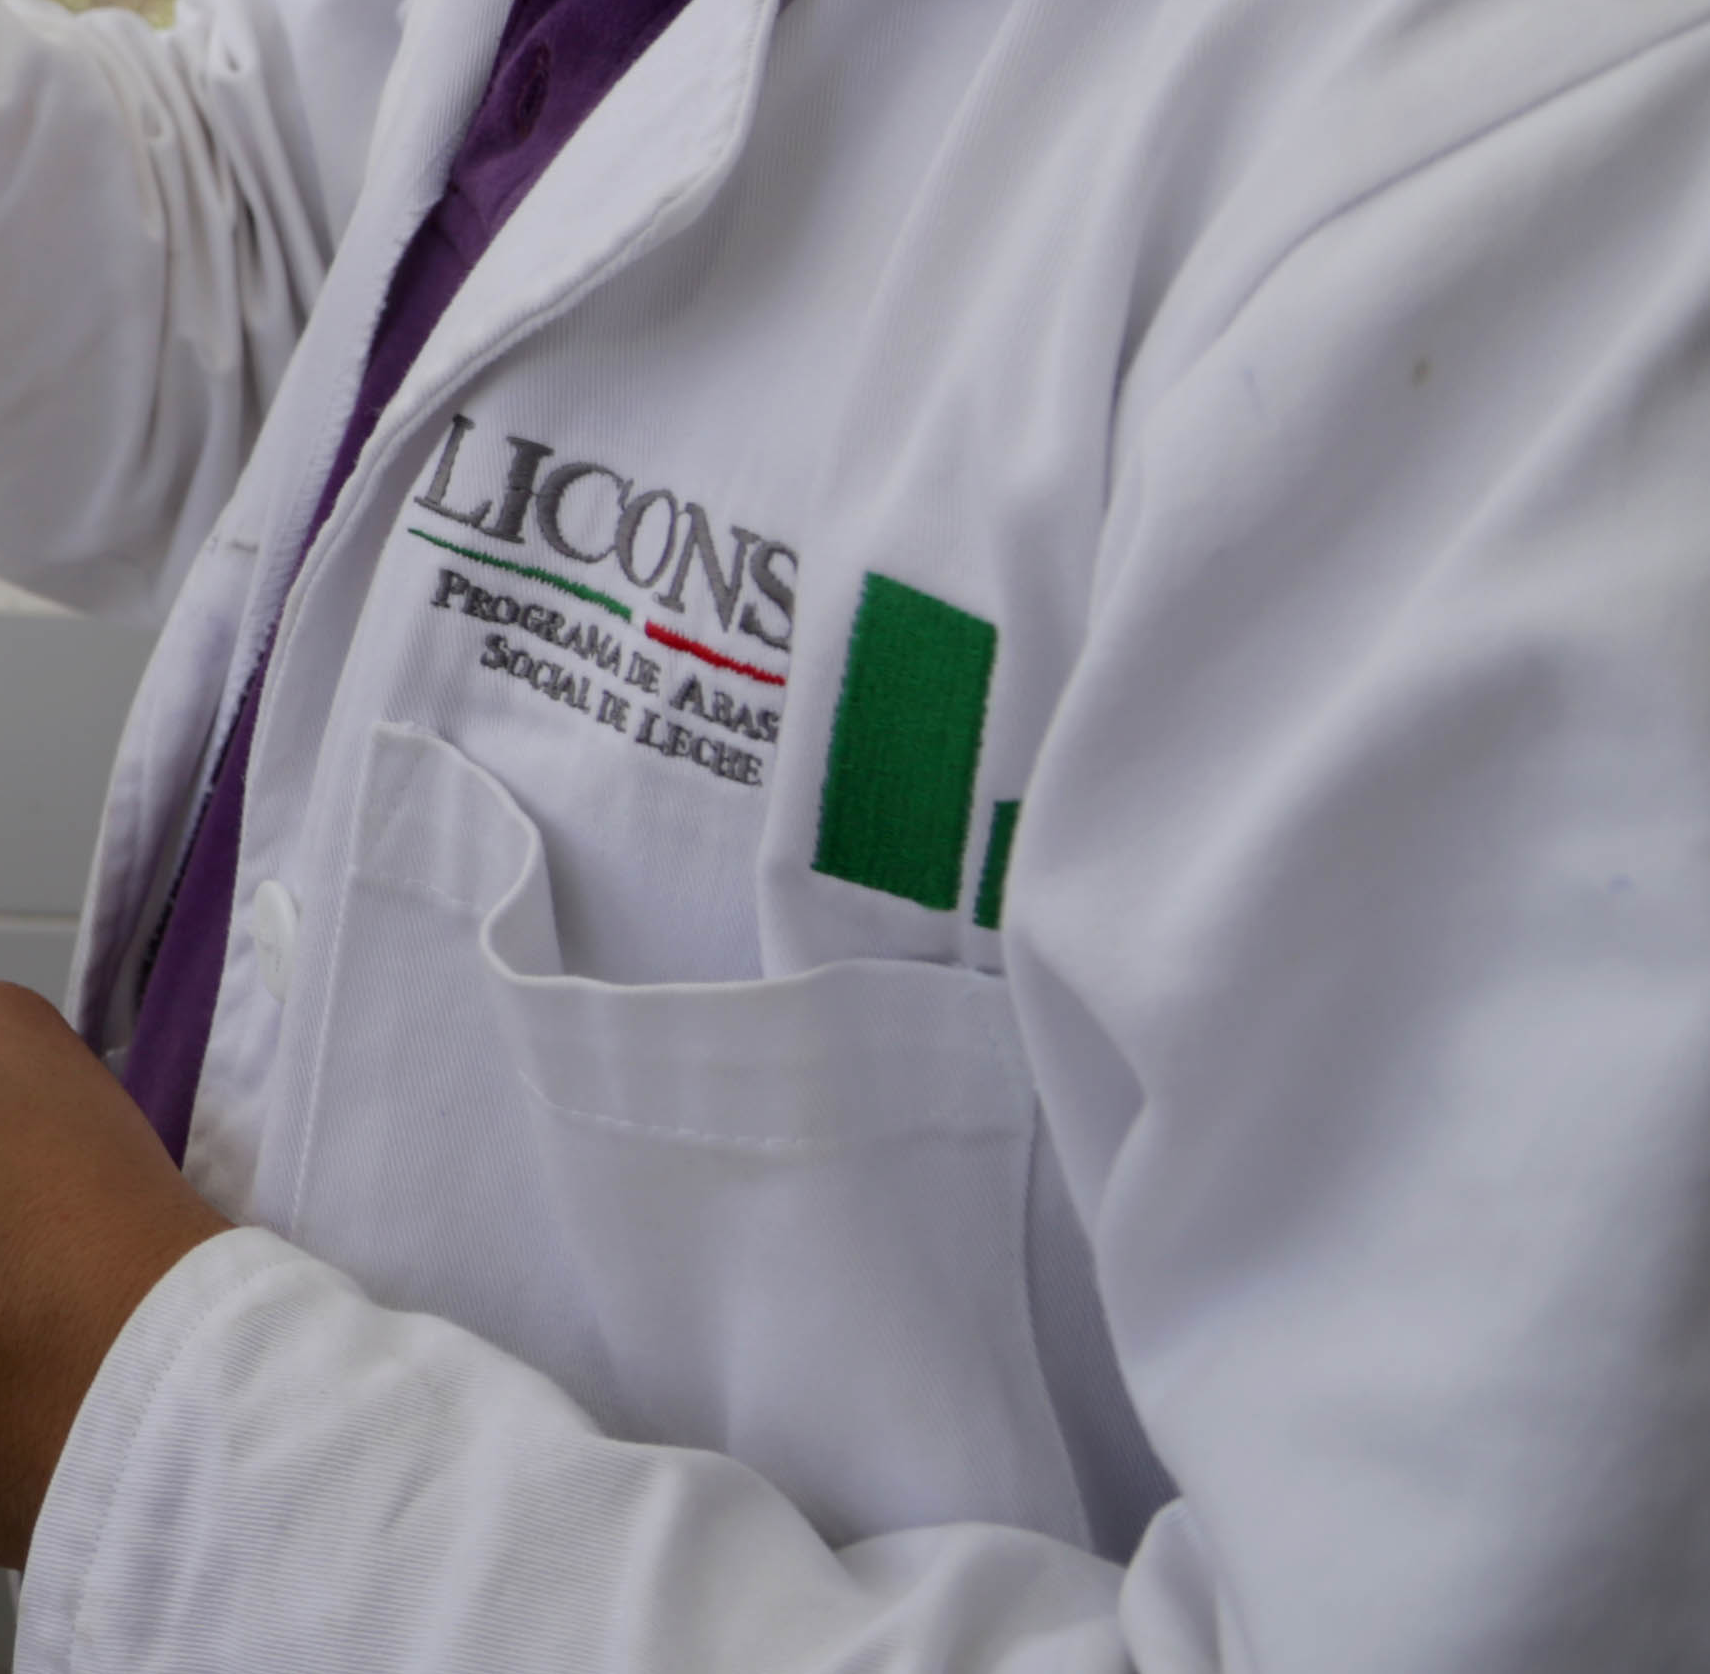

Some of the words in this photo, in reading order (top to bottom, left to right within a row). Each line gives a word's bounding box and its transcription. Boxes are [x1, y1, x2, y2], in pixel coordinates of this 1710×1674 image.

[414, 413, 799, 654] LICONS
[431, 568, 622, 677] PROGRAMA
[624, 651, 662, 696] DE
[669, 674, 780, 745] ABAS
[480, 632, 591, 714] SOCIAL
[596, 689, 631, 733] DE
[635, 707, 764, 787] LECHE
